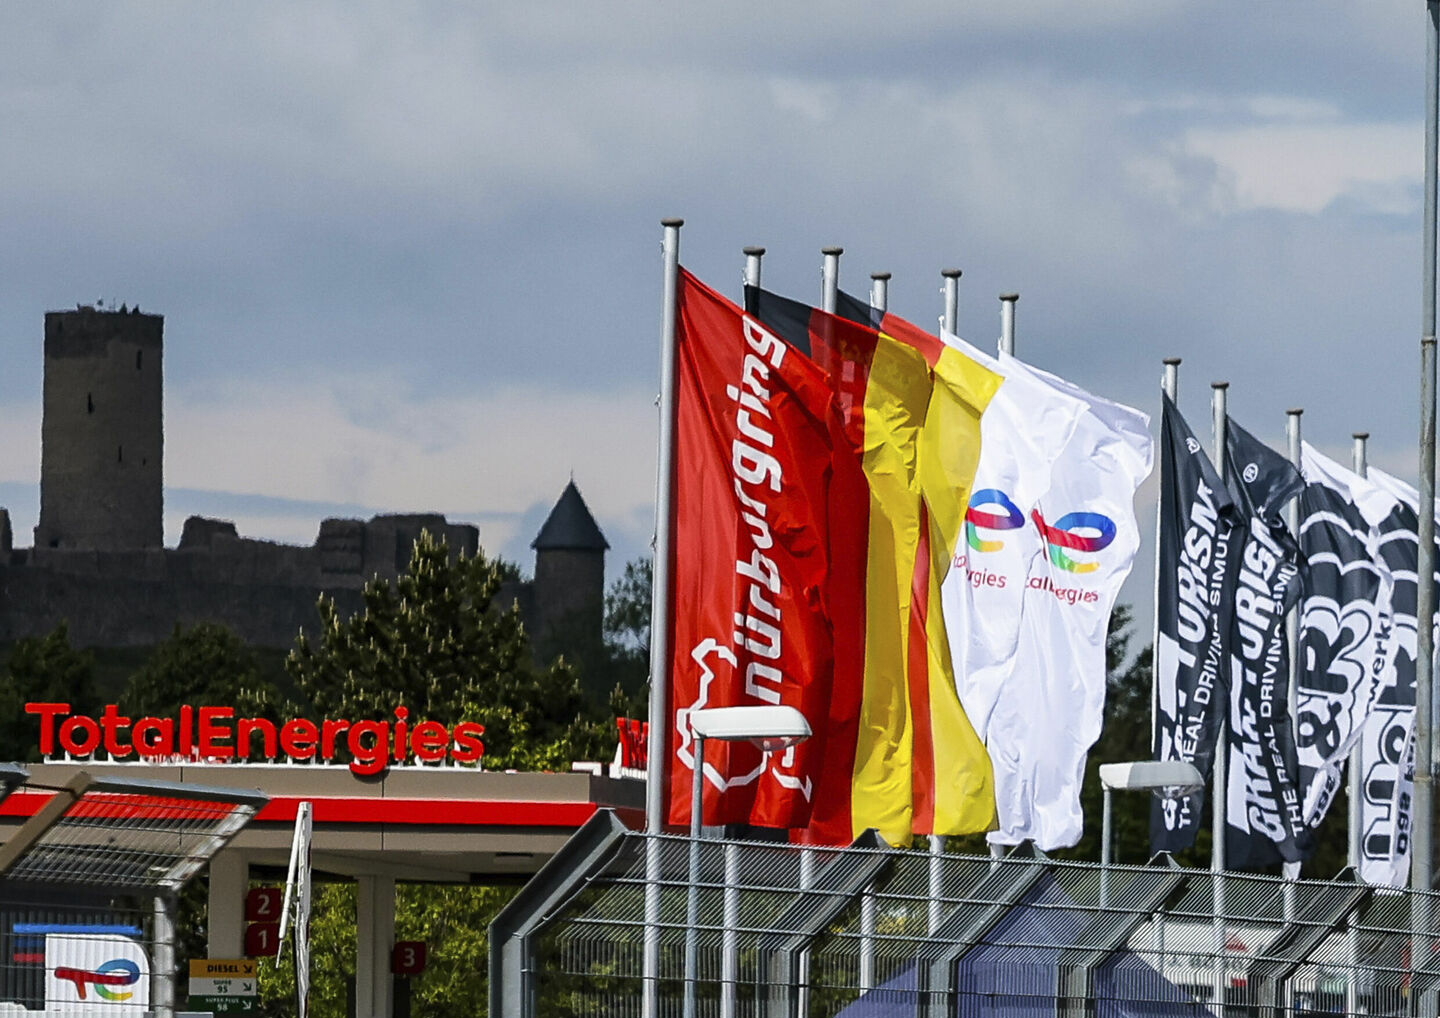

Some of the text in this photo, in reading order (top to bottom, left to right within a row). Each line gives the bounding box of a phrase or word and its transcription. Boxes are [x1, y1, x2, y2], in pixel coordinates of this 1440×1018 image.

[726, 315, 788, 705] nürburgring
[25, 702, 485, 775] TotalEnergies
[1264, 723, 1288, 784] REAL
[1283, 788, 1304, 838] THE
[257, 894, 271, 915] 2
[258, 930, 267, 949] 1
[402, 948, 415, 967] 3
[207, 964, 239, 973] DIESEL
[217, 985, 228, 993] 95
